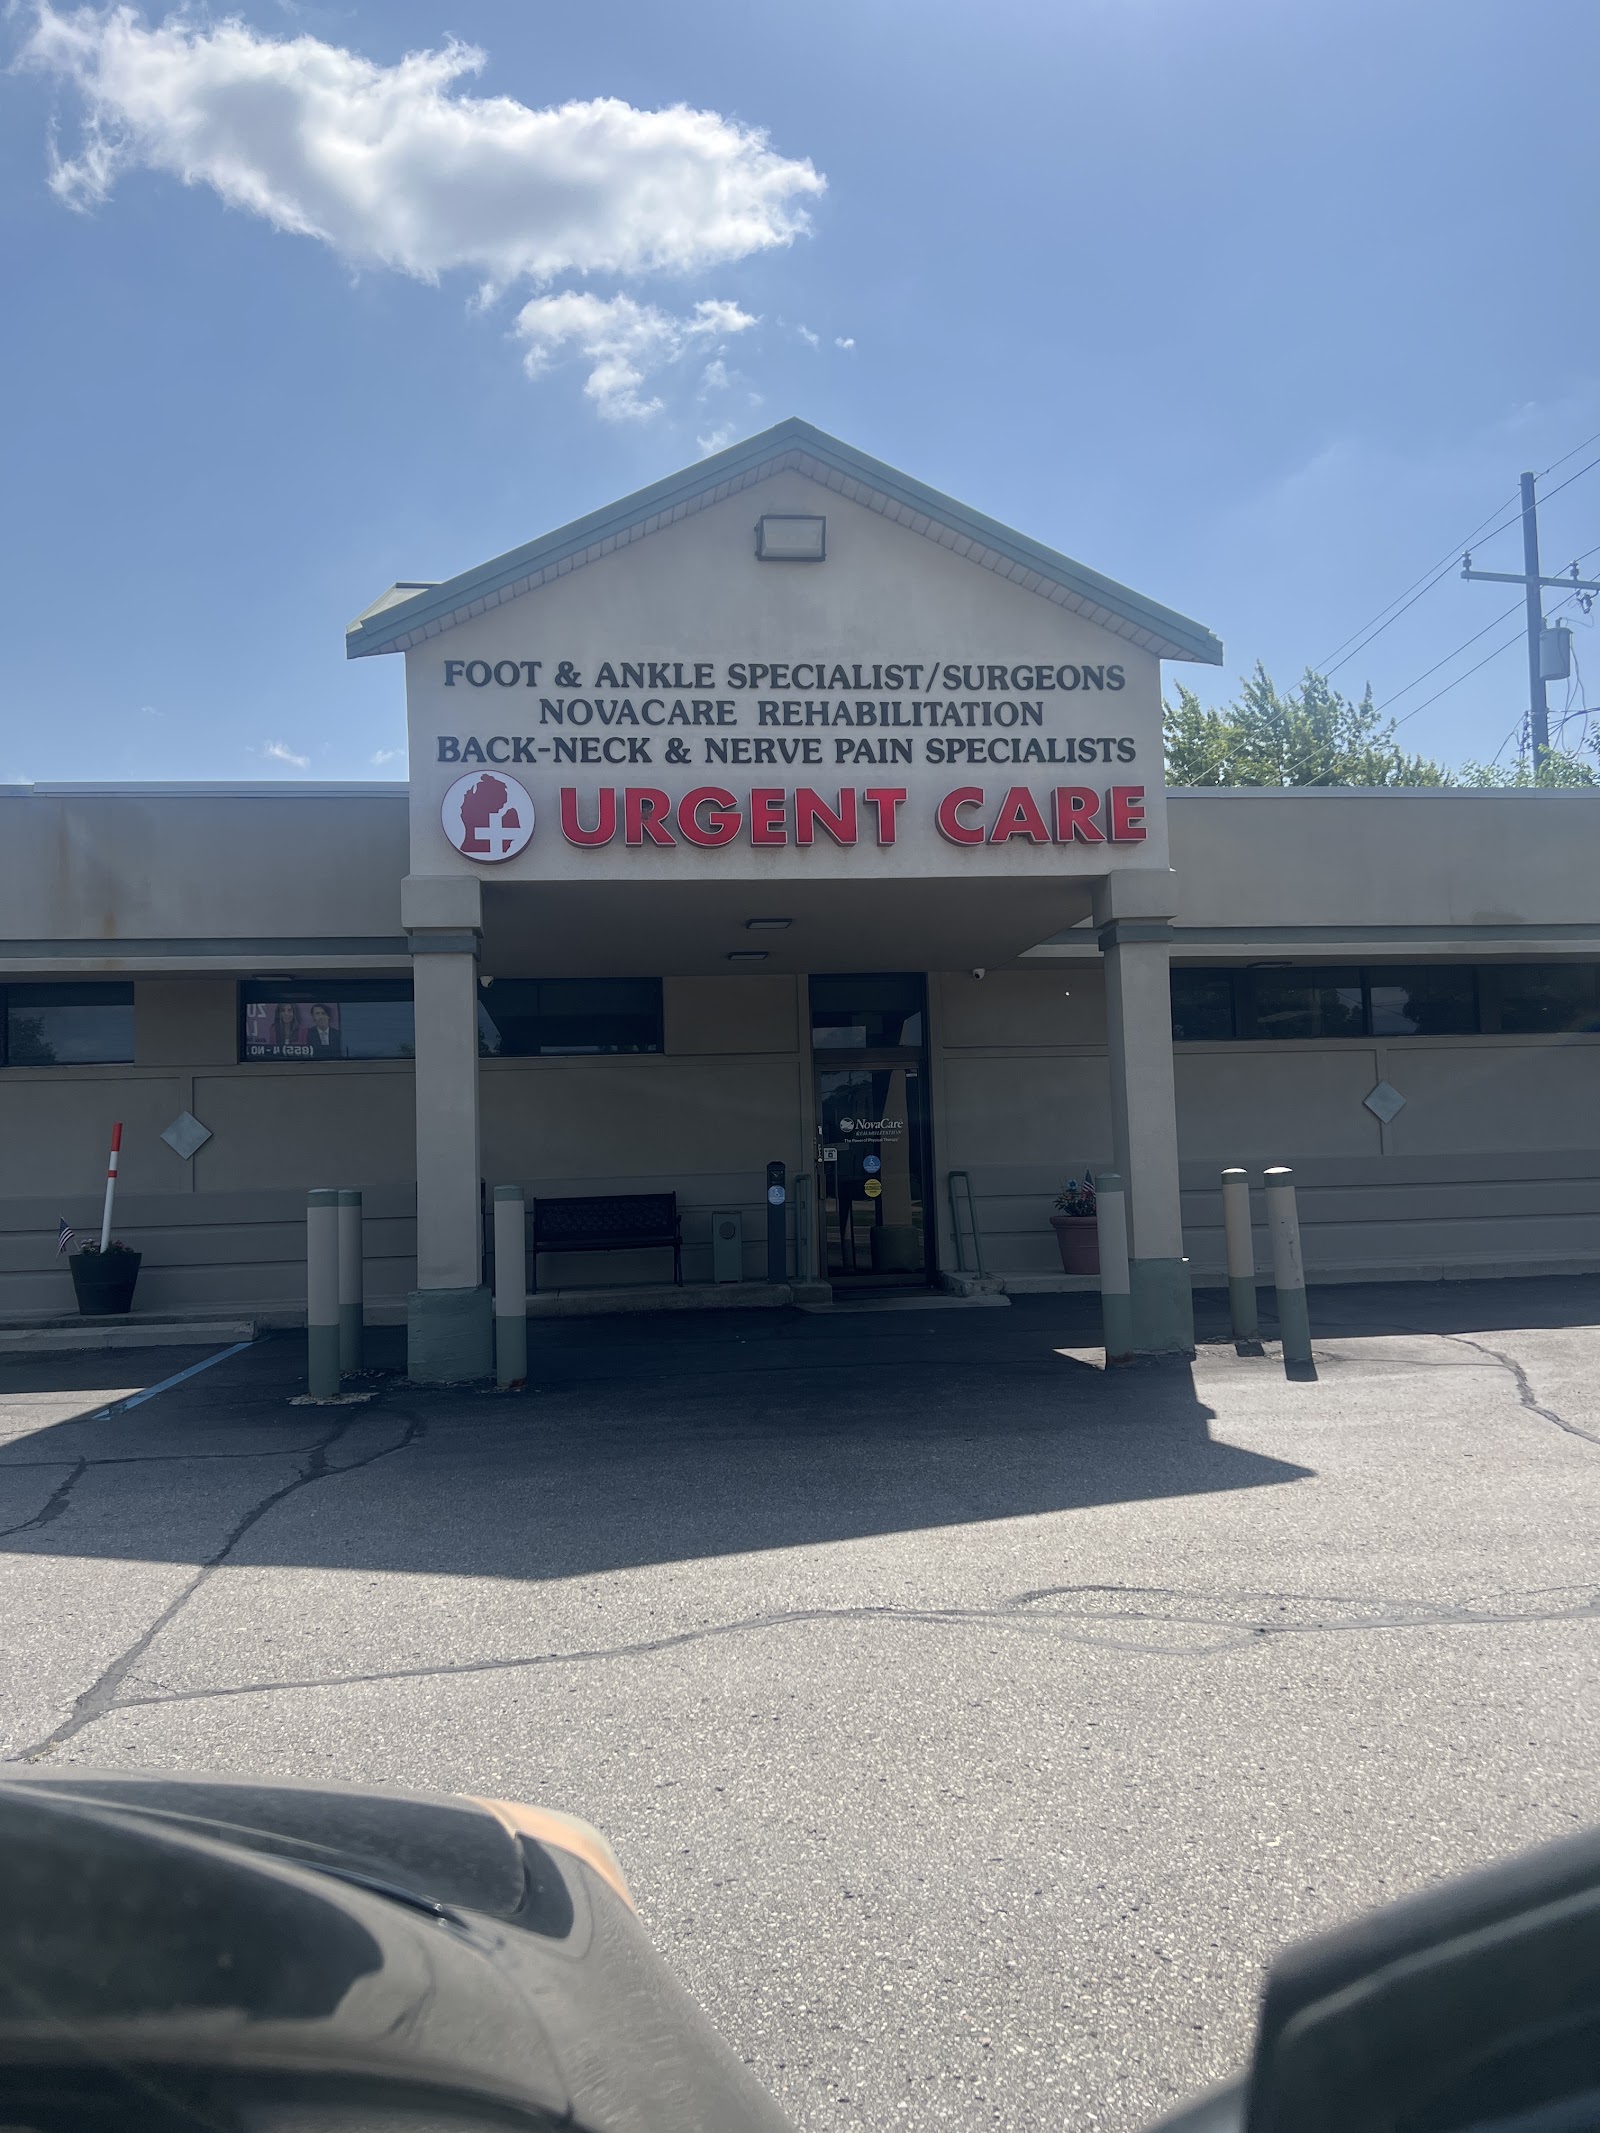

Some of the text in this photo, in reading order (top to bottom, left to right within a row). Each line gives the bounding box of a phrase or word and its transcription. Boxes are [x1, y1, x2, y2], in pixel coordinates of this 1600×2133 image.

[444, 660, 1126, 693] FOOT & ANKLE SPECIALIST/SURGEONS
[539, 698, 1044, 727] NOVACARE REHABILITATION
[436, 736, 1137, 764] BACK-NECK & NERVE PAIN SPECIALISTS
[559, 785, 1148, 848] URGENT CARE
[854, 1118, 904, 1130] NovaCare
